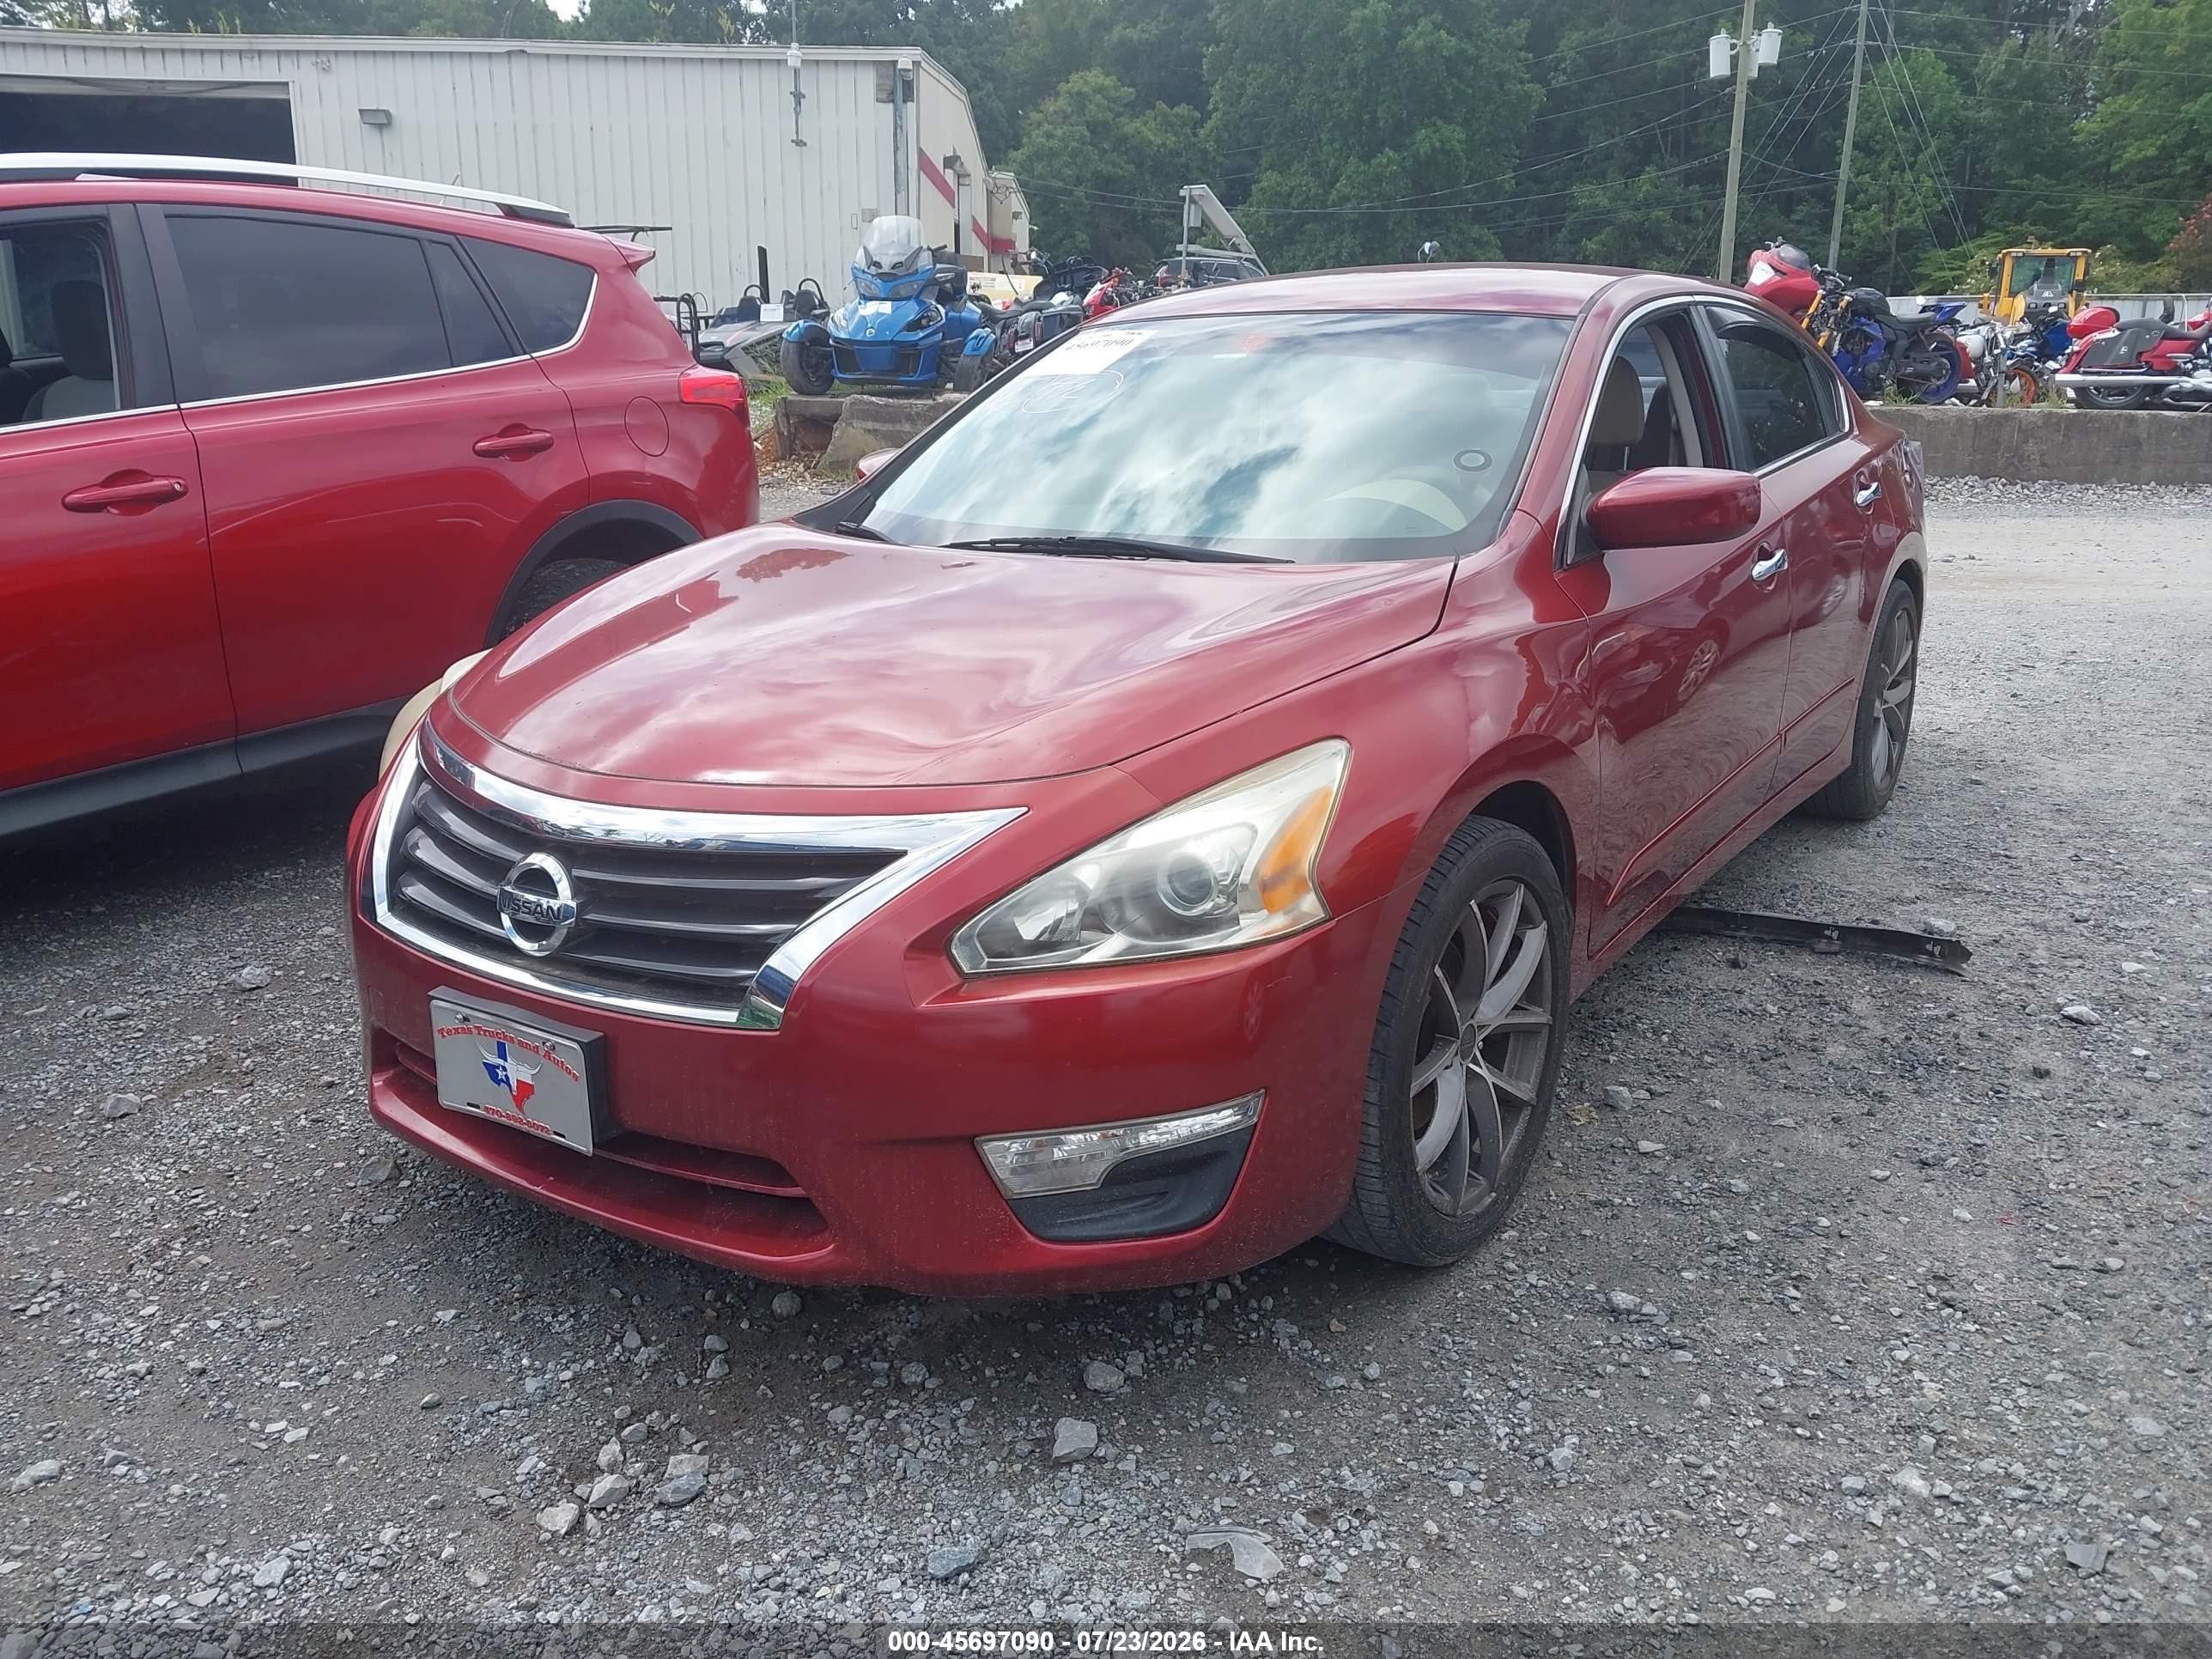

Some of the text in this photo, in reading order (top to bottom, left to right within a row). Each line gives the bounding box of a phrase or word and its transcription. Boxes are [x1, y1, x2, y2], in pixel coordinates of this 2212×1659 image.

[439, 1024, 580, 1082] Texas Trucks and Autos
